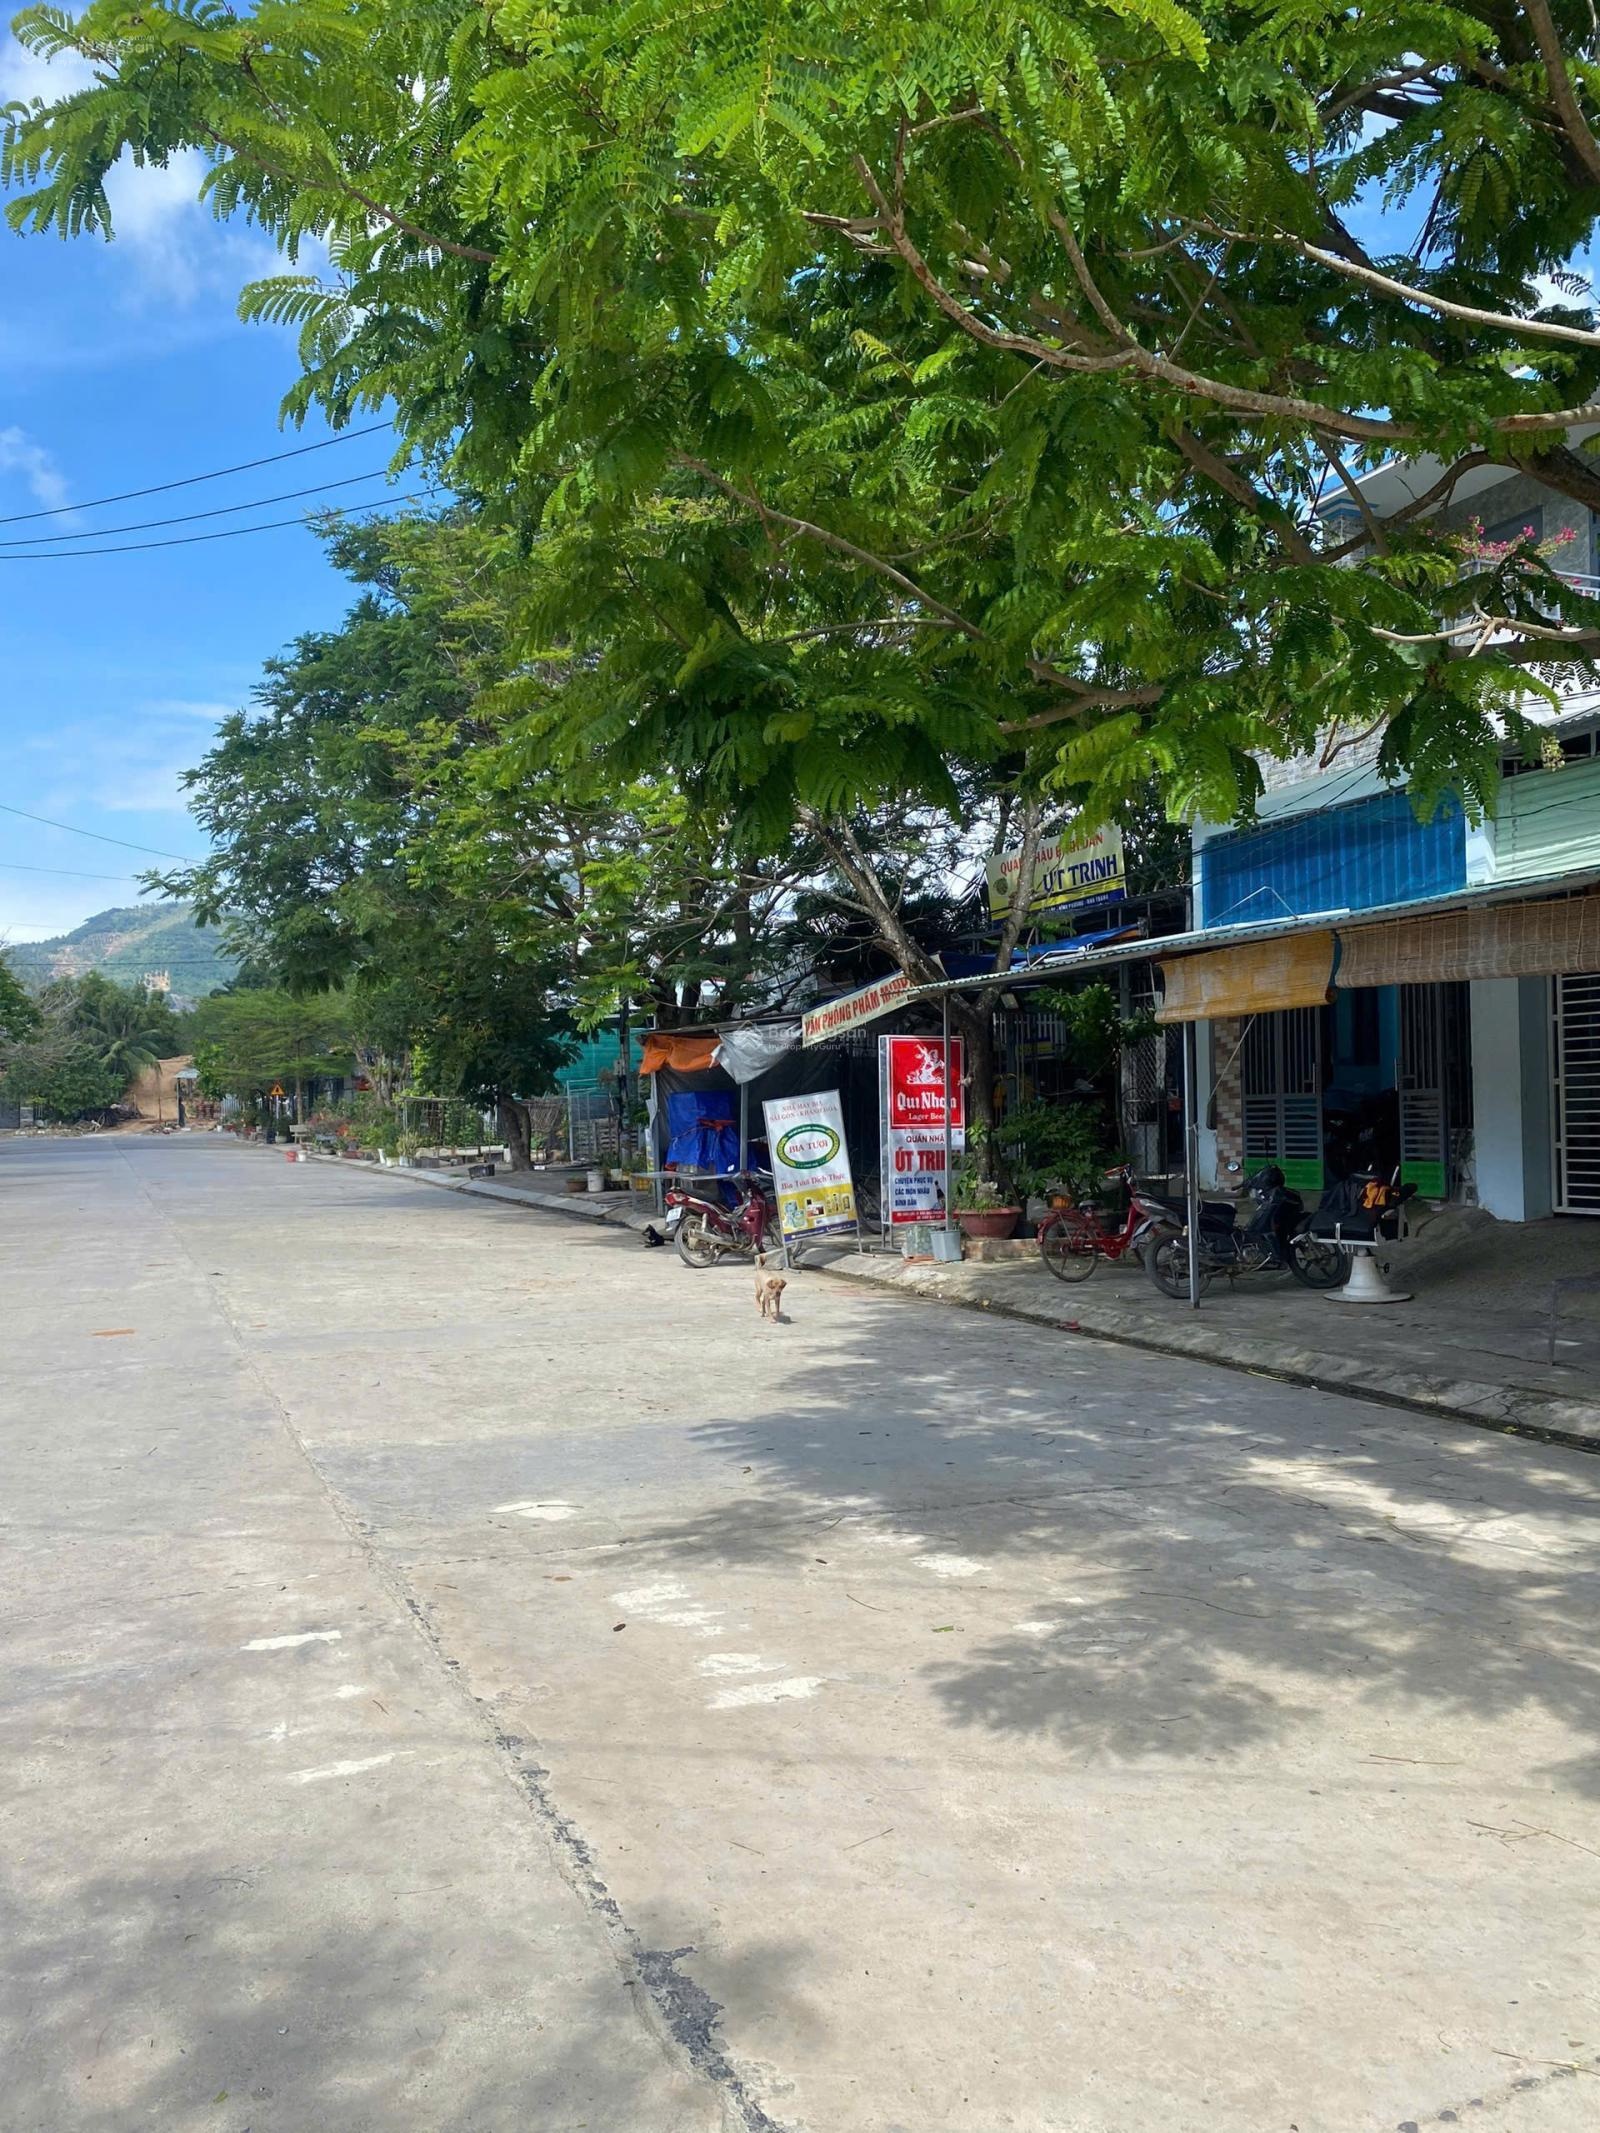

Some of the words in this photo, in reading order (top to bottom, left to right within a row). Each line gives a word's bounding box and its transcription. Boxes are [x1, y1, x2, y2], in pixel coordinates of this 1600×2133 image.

[1035, 846, 1054, 865] HẬU
[1067, 853, 1118, 887] TRINH
[908, 1112, 928, 1121] Lager
[929, 1133, 945, 1145] NHẬ
[895, 1146, 914, 1173] ÚT
